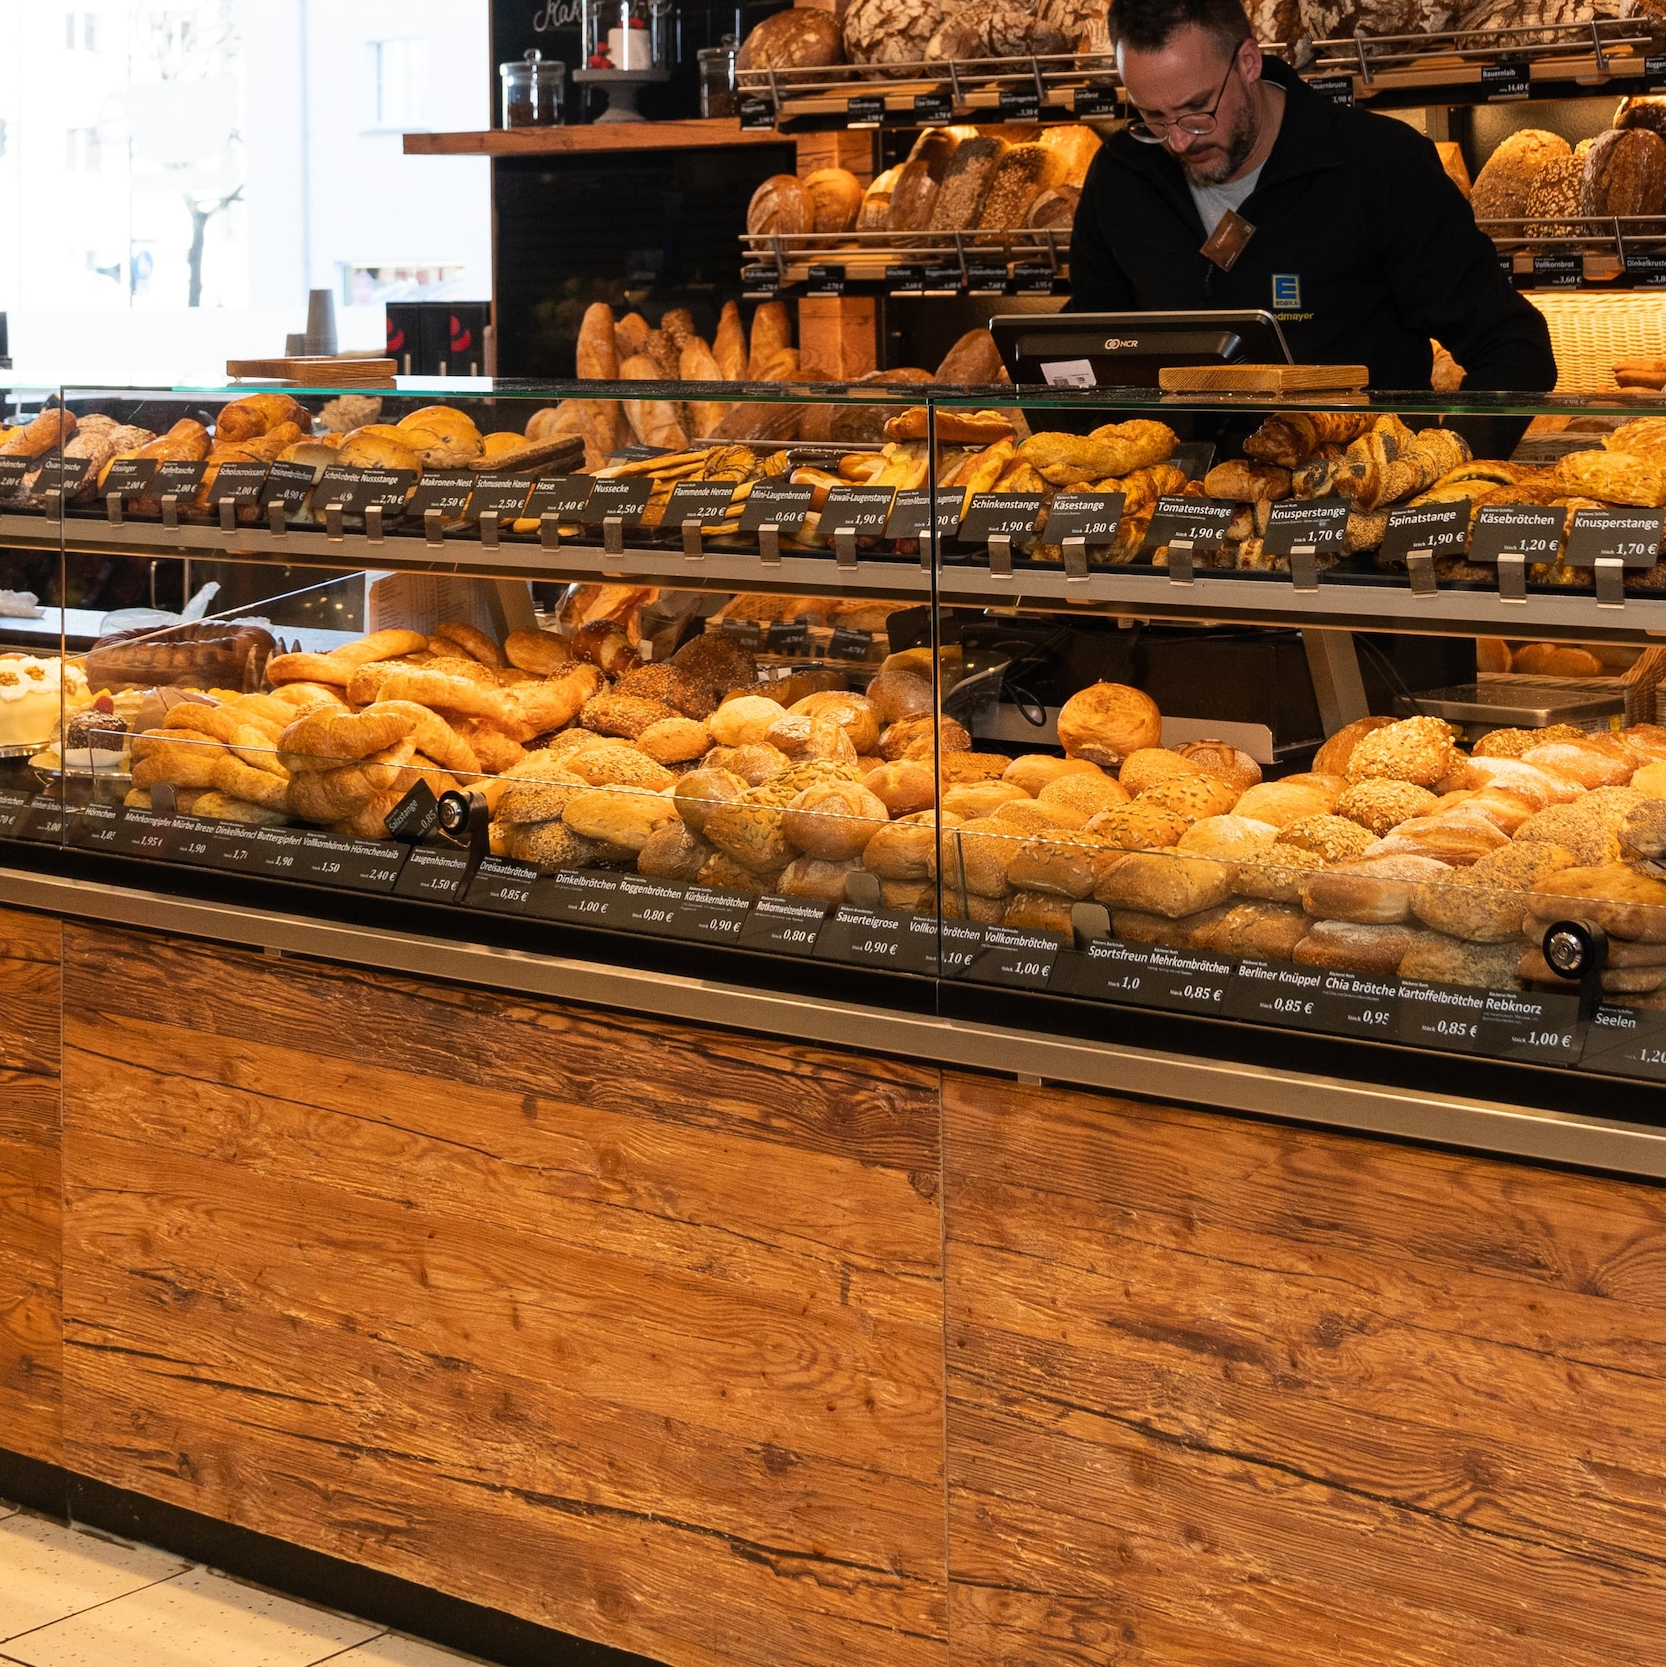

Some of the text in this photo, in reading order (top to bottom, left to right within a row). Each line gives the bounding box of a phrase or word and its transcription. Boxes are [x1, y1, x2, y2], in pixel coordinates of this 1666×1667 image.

[1311, 81, 1347, 90] auernkruste
[1535, 260, 1574, 269] Vollkornbrot
[1119, 340, 1138, 348] NCR
[218, 468, 266, 477] Schokocroissant
[360, 474, 399, 486] Nussstange
[420, 477, 473, 488] Makronen-Nest
[476, 478, 531, 489] Schmusende Hasen
[536, 482, 555, 491] Hase
[593, 483, 630, 495] Nussecke
[673, 486, 733, 498] Flammende Herzen
[750, 489, 812, 501] Mini-Laugenbrezeln
[971, 499, 1040, 511] Schinkenstange
[1053, 500, 1105, 512] Käsestange
[1158, 501, 1232, 517] Tomatenstange
[1270, 506, 1346, 520] Knusperstange
[1389, 510, 1457, 527] Spinatstange
[1479, 513, 1555, 526] Käsebrötchen
[1000, 521, 1021, 533] 1,90
[1084, 522, 1106, 535] 1,80
[1574, 517, 1659, 531] Knusperstange
[1188, 527, 1213, 540] 1,90
[1307, 529, 1333, 543] 1,70
[1427, 533, 1453, 547] 1,90
[1518, 539, 1546, 553] 1,20
[1615, 543, 1643, 556] 1,70
[84, 806, 116, 819] Hörnchen
[389, 797, 419, 833] Salzstange
[411, 852, 466, 870] Laugenhörnchen
[479, 860, 537, 879] Dreisaatbrötchen
[555, 872, 617, 891] Dinkelbrötchen
[619, 880, 682, 900] Roggenbrötchen
[684, 890, 750, 909] Kürbiskernbrötchen
[755, 900, 824, 919] Rotkornweizenbrötchen
[836, 911, 899, 930] Sauerteigrose
[909, 920, 980, 940] Vollkorbrötchen
[984, 931, 1058, 951] Vollkornbrötchen
[1150, 953, 1229, 975] Mehrkornbrötchen
[1238, 965, 1320, 987] Berliner Knüppel
[1325, 977, 1350, 991] Chia
[1273, 997, 1303, 1014] 0,85
[1485, 997, 1542, 1015] Rebknorz
[1437, 1019, 1466, 1036] 0,85
[1594, 1012, 1636, 1029] Seelen
[1527, 1031, 1558, 1047] 1,00
